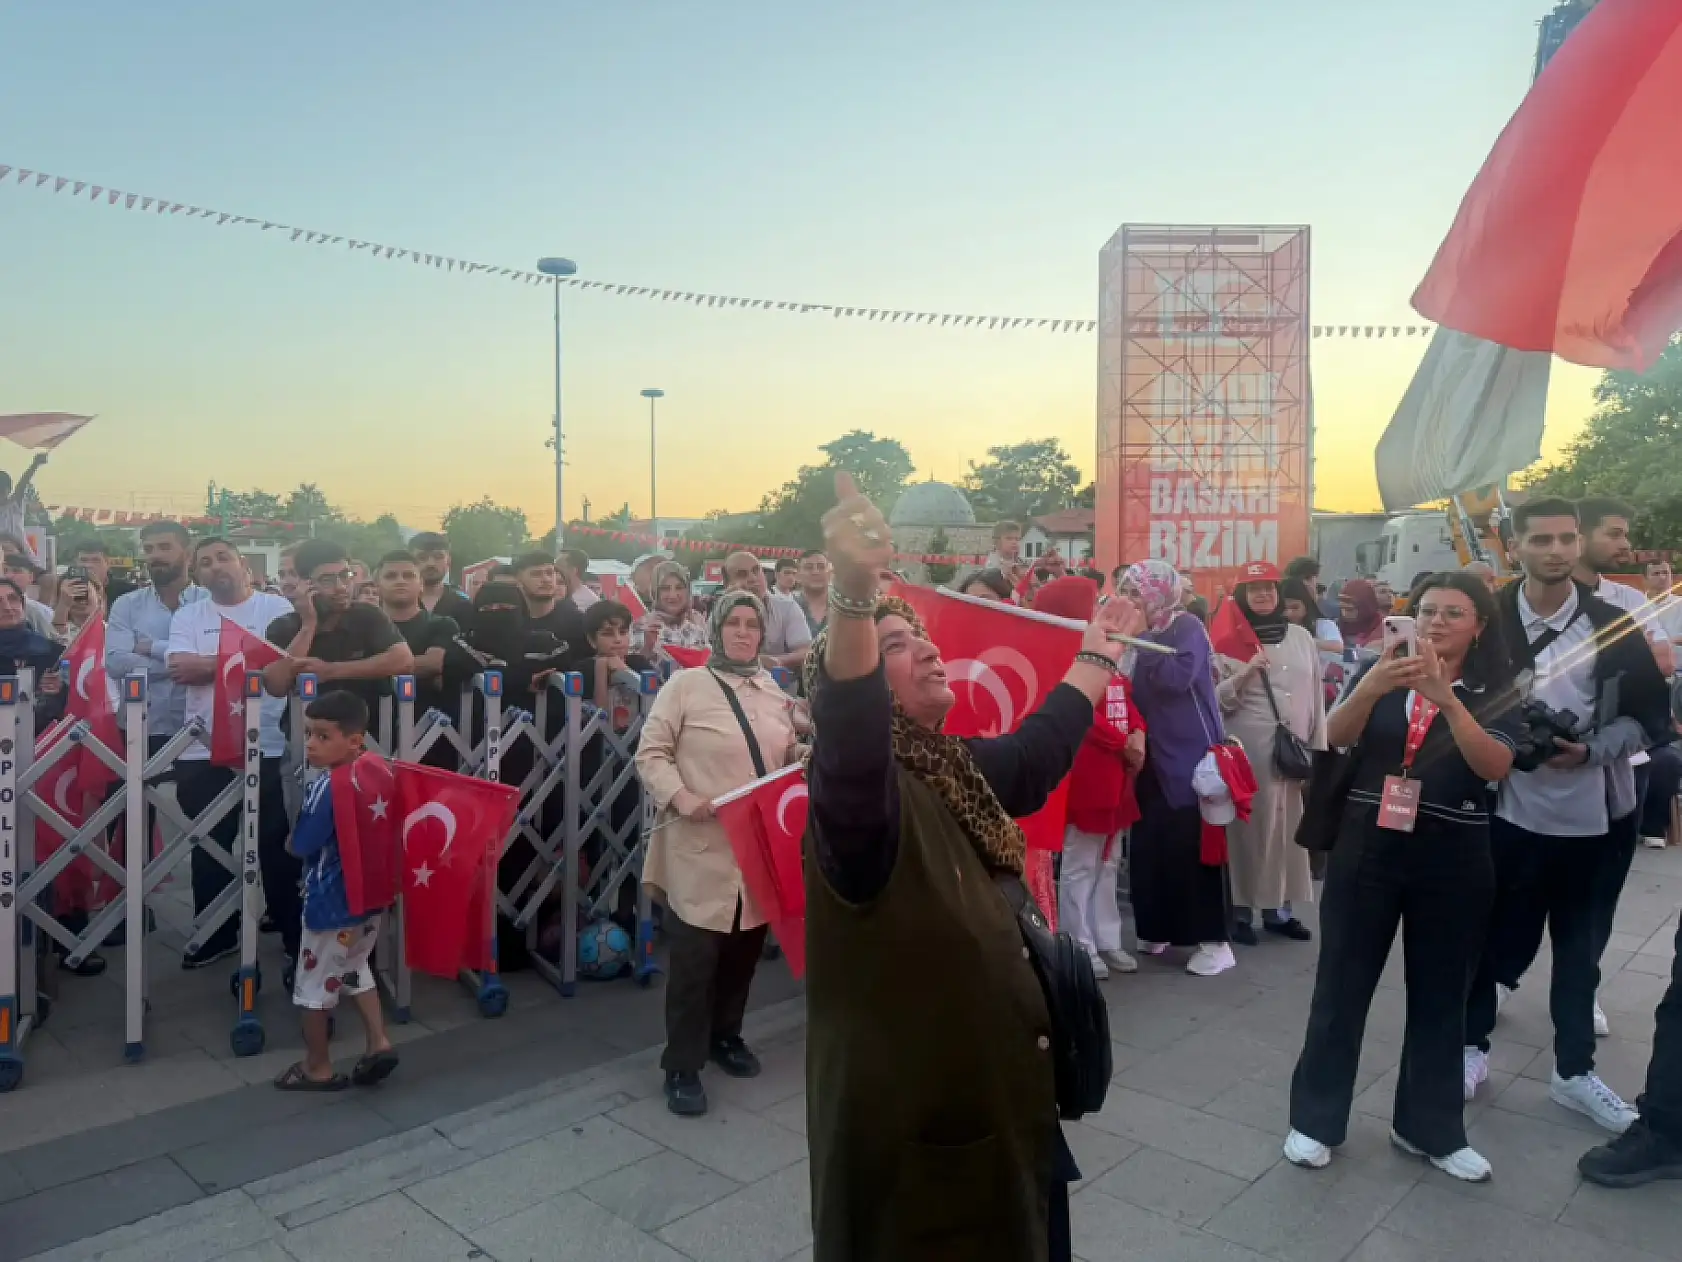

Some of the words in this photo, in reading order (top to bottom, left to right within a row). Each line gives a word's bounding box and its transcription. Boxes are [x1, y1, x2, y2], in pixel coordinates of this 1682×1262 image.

[1150, 519, 1278, 568] BİZİM
[1, 760, 13, 886] POLİS
[246, 748, 258, 864] POLİS
